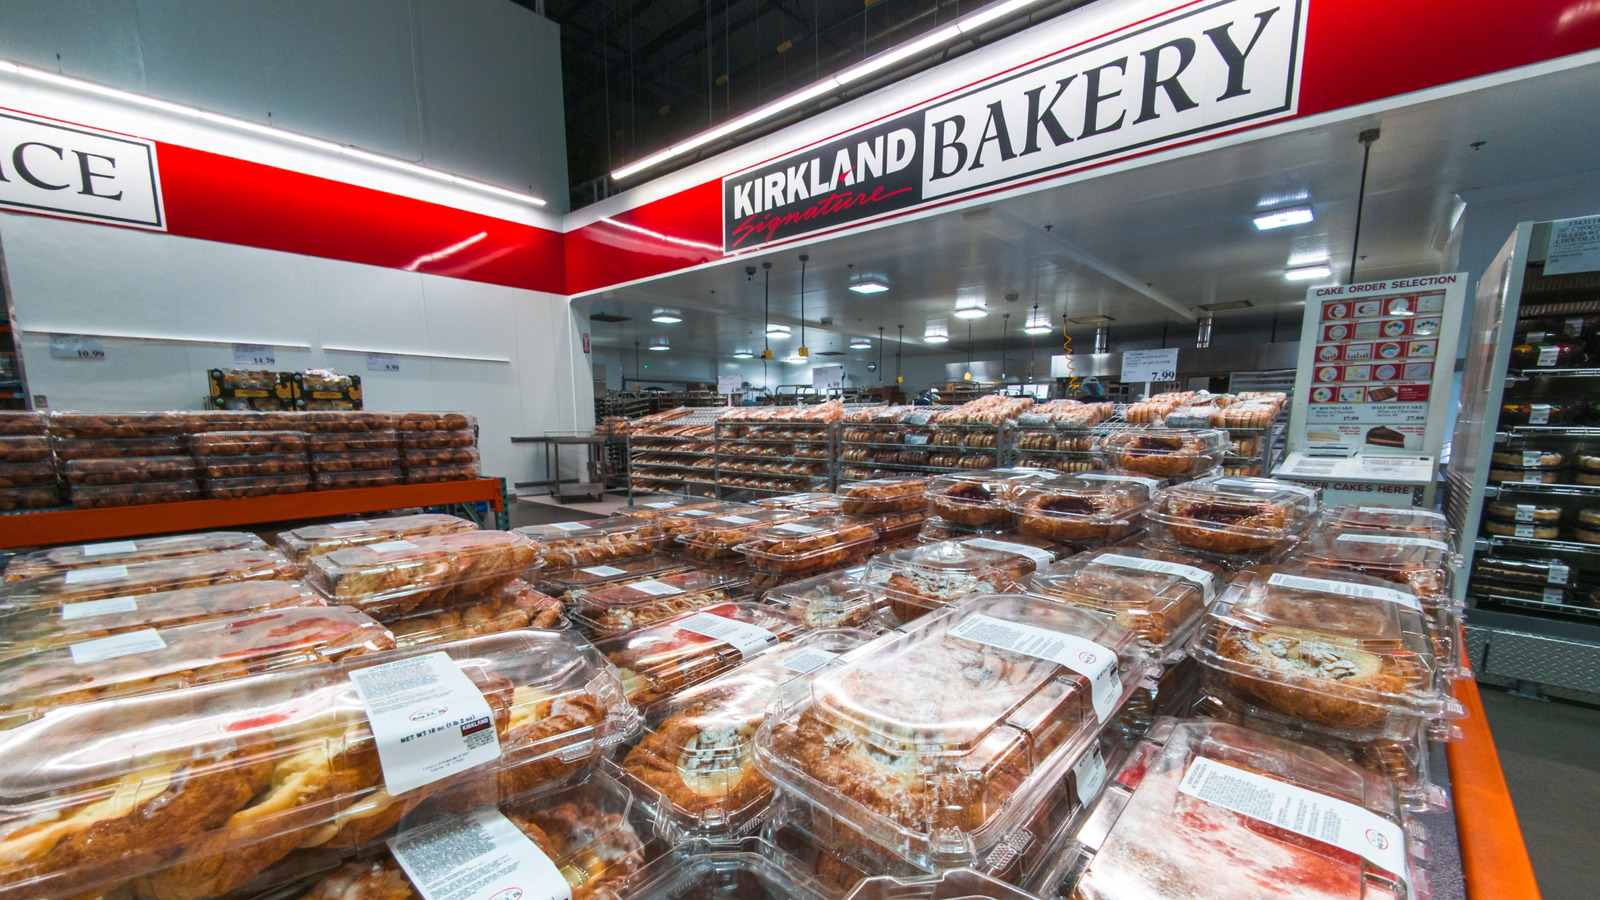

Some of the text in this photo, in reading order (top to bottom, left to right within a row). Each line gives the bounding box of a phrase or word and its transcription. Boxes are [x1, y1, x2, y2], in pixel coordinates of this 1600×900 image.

[928, 6, 1280, 184] BAKERY
[733, 127, 917, 220] KIRKLAND
[731, 185, 914, 248] Signature
[1316, 286, 1344, 297] CAKE
[1348, 282, 1386, 294] ORDER
[1391, 275, 1457, 289] SELECTION
[78, 349, 104, 358] 10.99
[1151, 371, 1175, 381] 7.99
[1333, 482, 1373, 492] CAKES
[1377, 485, 1410, 494] HERE
[400, 735, 414, 744] NET
[416, 730, 427, 738] WT
[428, 727, 436, 735] 18
